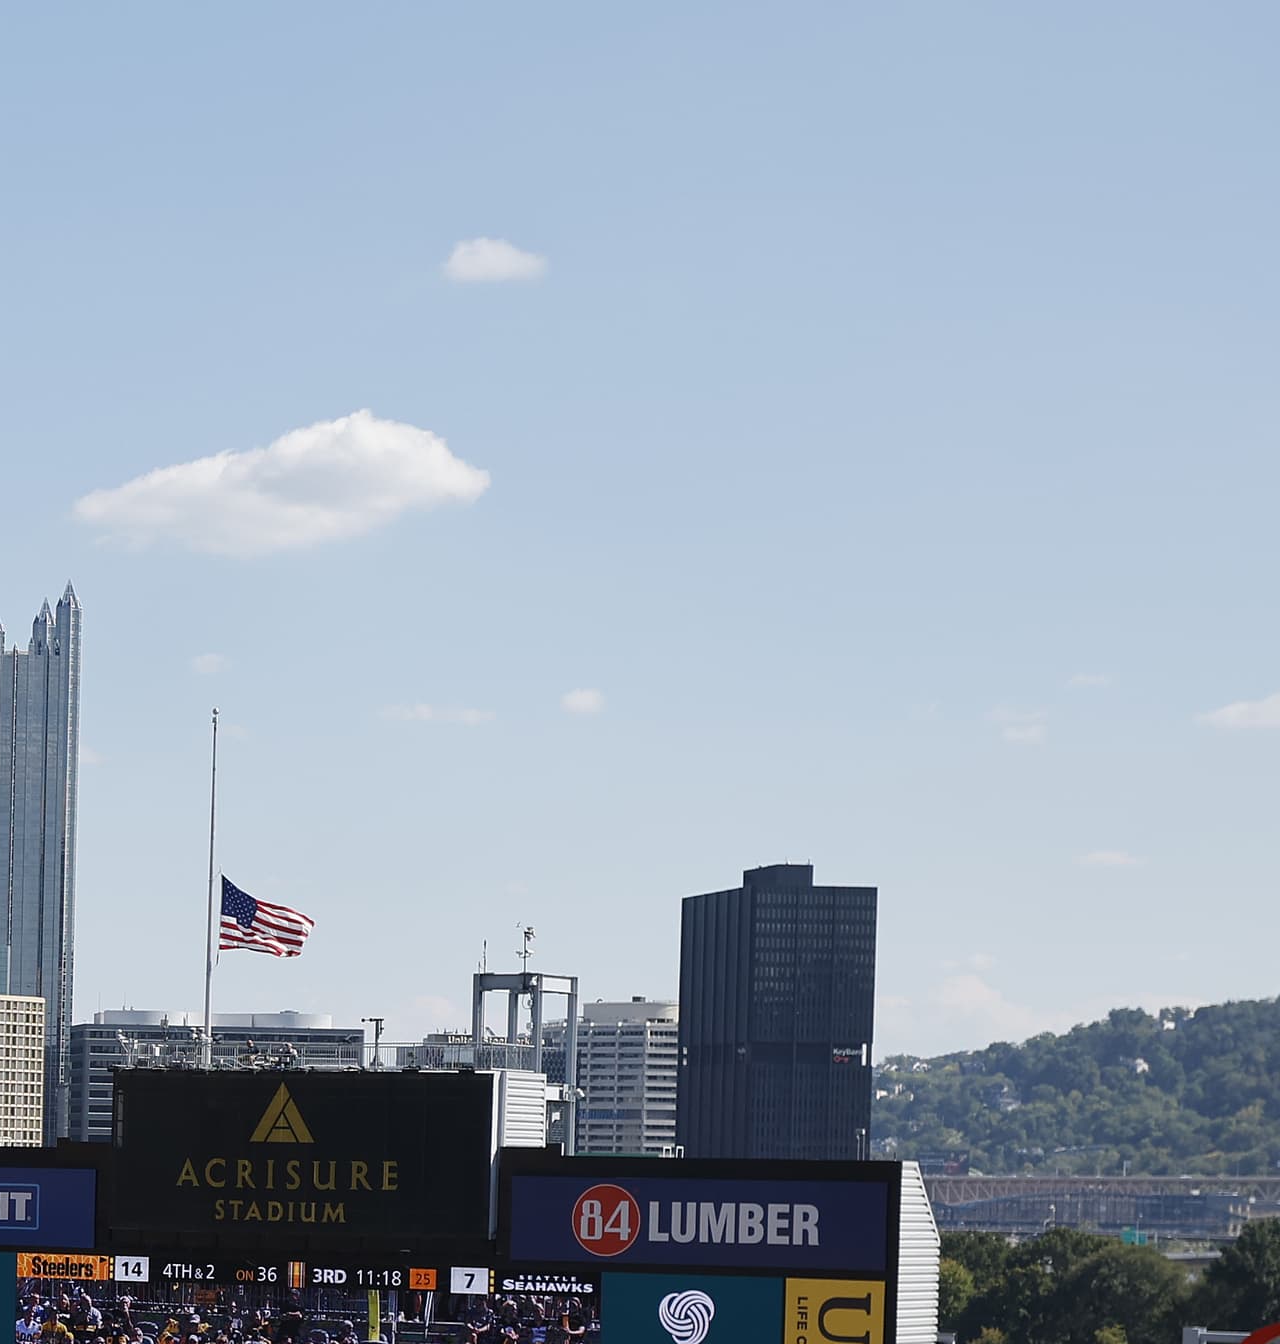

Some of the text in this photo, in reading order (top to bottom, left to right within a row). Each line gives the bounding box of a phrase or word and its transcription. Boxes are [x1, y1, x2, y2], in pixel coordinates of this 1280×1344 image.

[177, 1157, 399, 1191] ACRISURE
[214, 1200, 346, 1224] STADIUM
[579, 1200, 820, 1247] 84 LUMBER
[32, 1255, 93, 1277] Steelers
[121, 1261, 143, 1277] 14
[163, 1264, 277, 1281] 4TH & 2 ON 36
[312, 1268, 402, 1286] 3RD 11:18
[415, 1273, 431, 1286] 25
[464, 1273, 476, 1289] 7
[519, 1274, 578, 1283] SEATTLE
[502, 1279, 594, 1294] SEAHAWKS
[797, 1296, 808, 1335] LIFE
